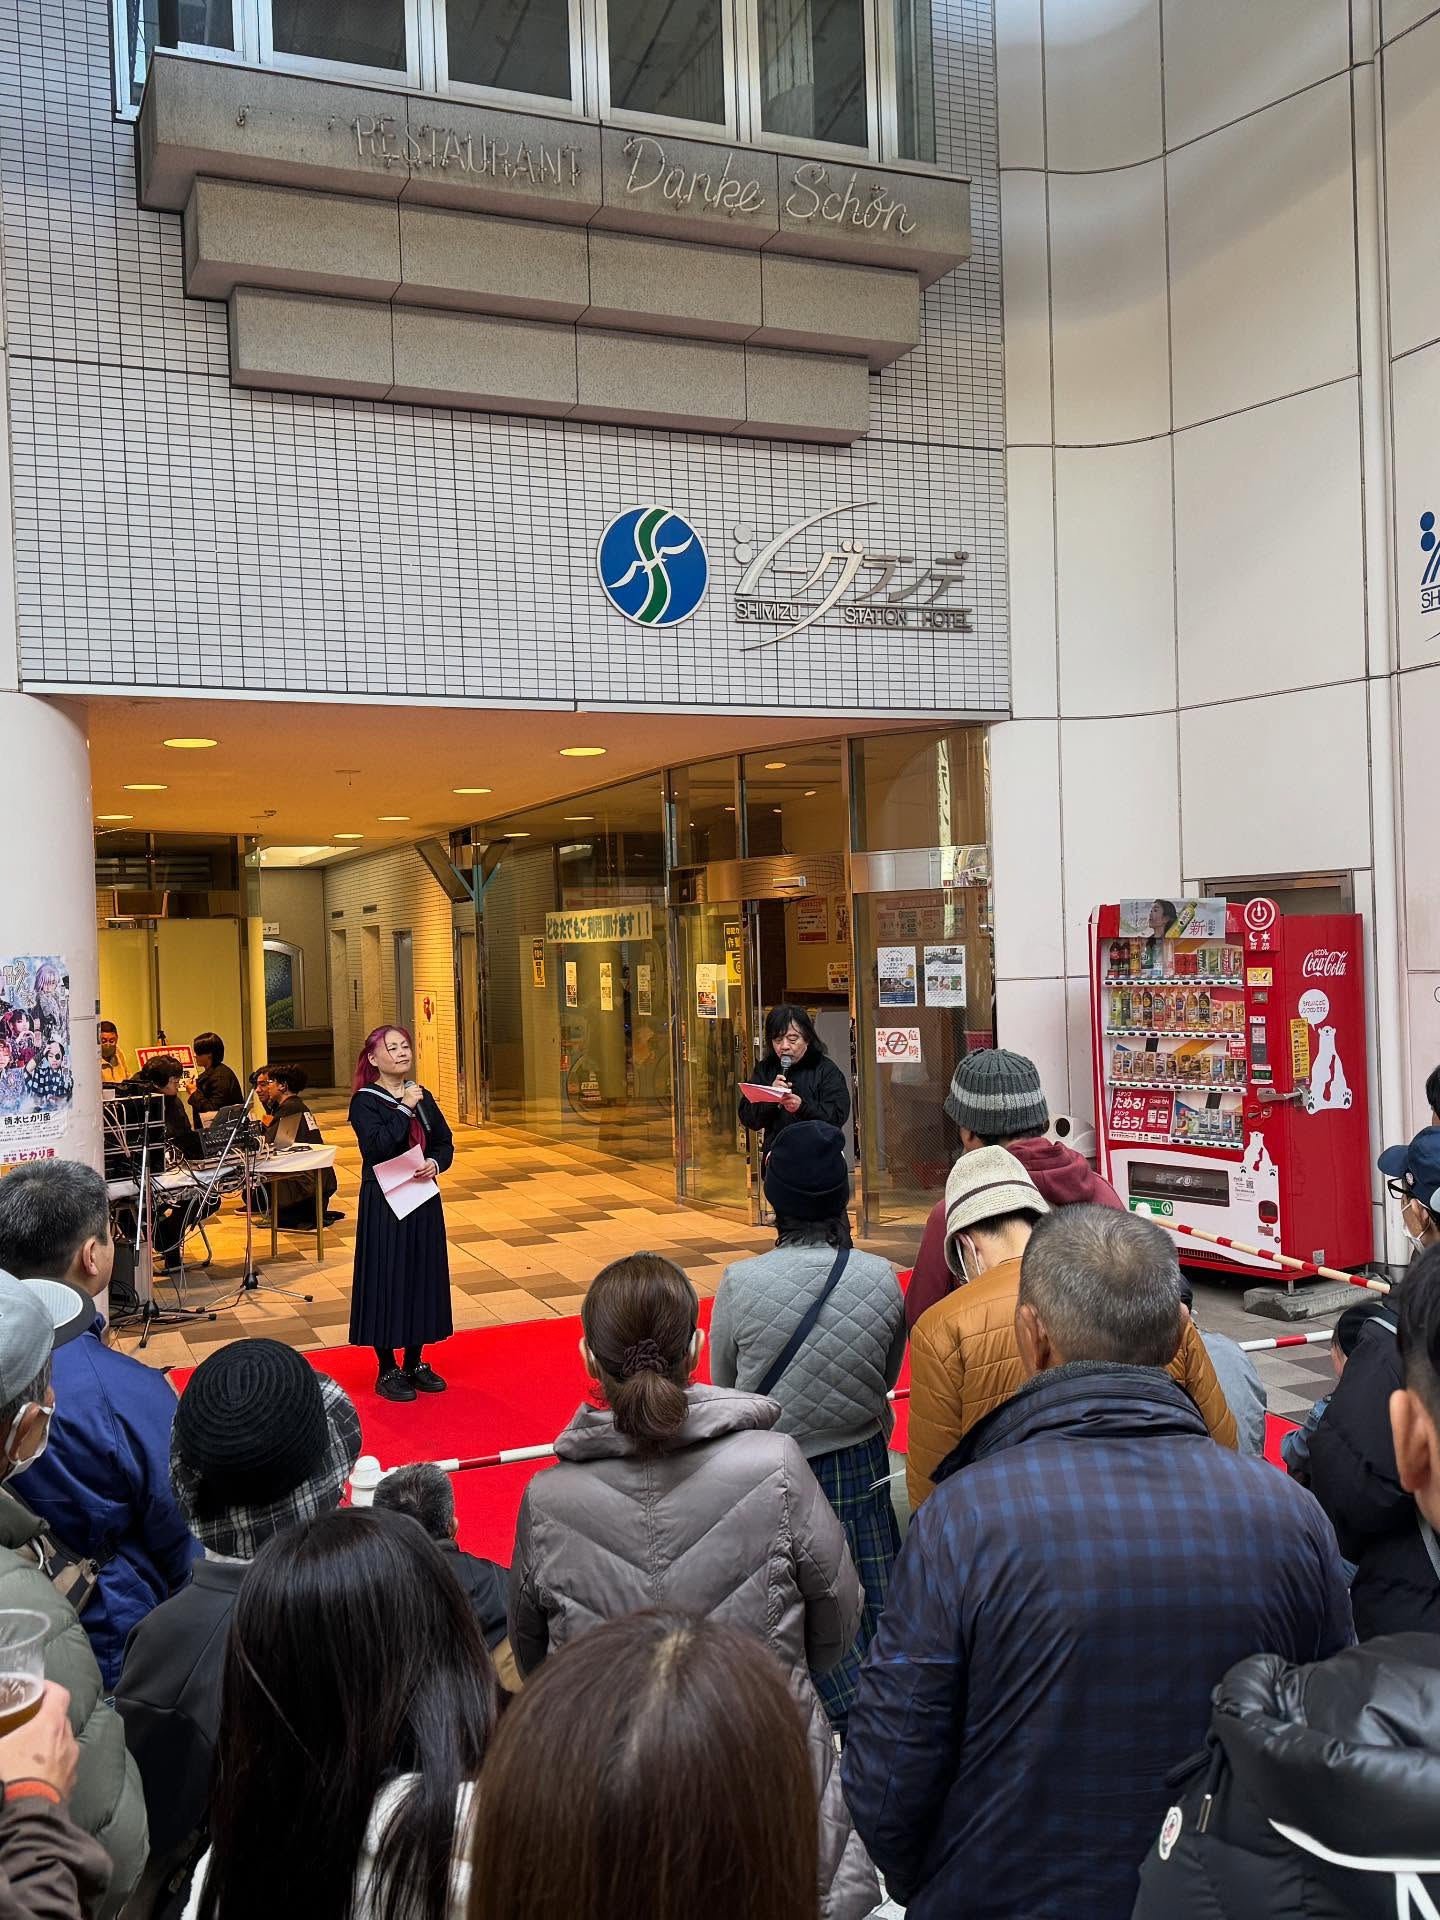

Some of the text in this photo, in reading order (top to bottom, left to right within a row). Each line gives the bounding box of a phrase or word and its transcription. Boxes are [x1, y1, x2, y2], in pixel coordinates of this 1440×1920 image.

[356, 114, 582, 187] RESTAURANT
[622, 137, 765, 212] Danke
[735, 602, 971, 629] SHIMIZU STATION HOTEL
[1302, 951, 1349, 978] Coca-Cola
[1114, 1097, 1146, 1110] ためる!
[1112, 1115, 1145, 1130] もらう!
